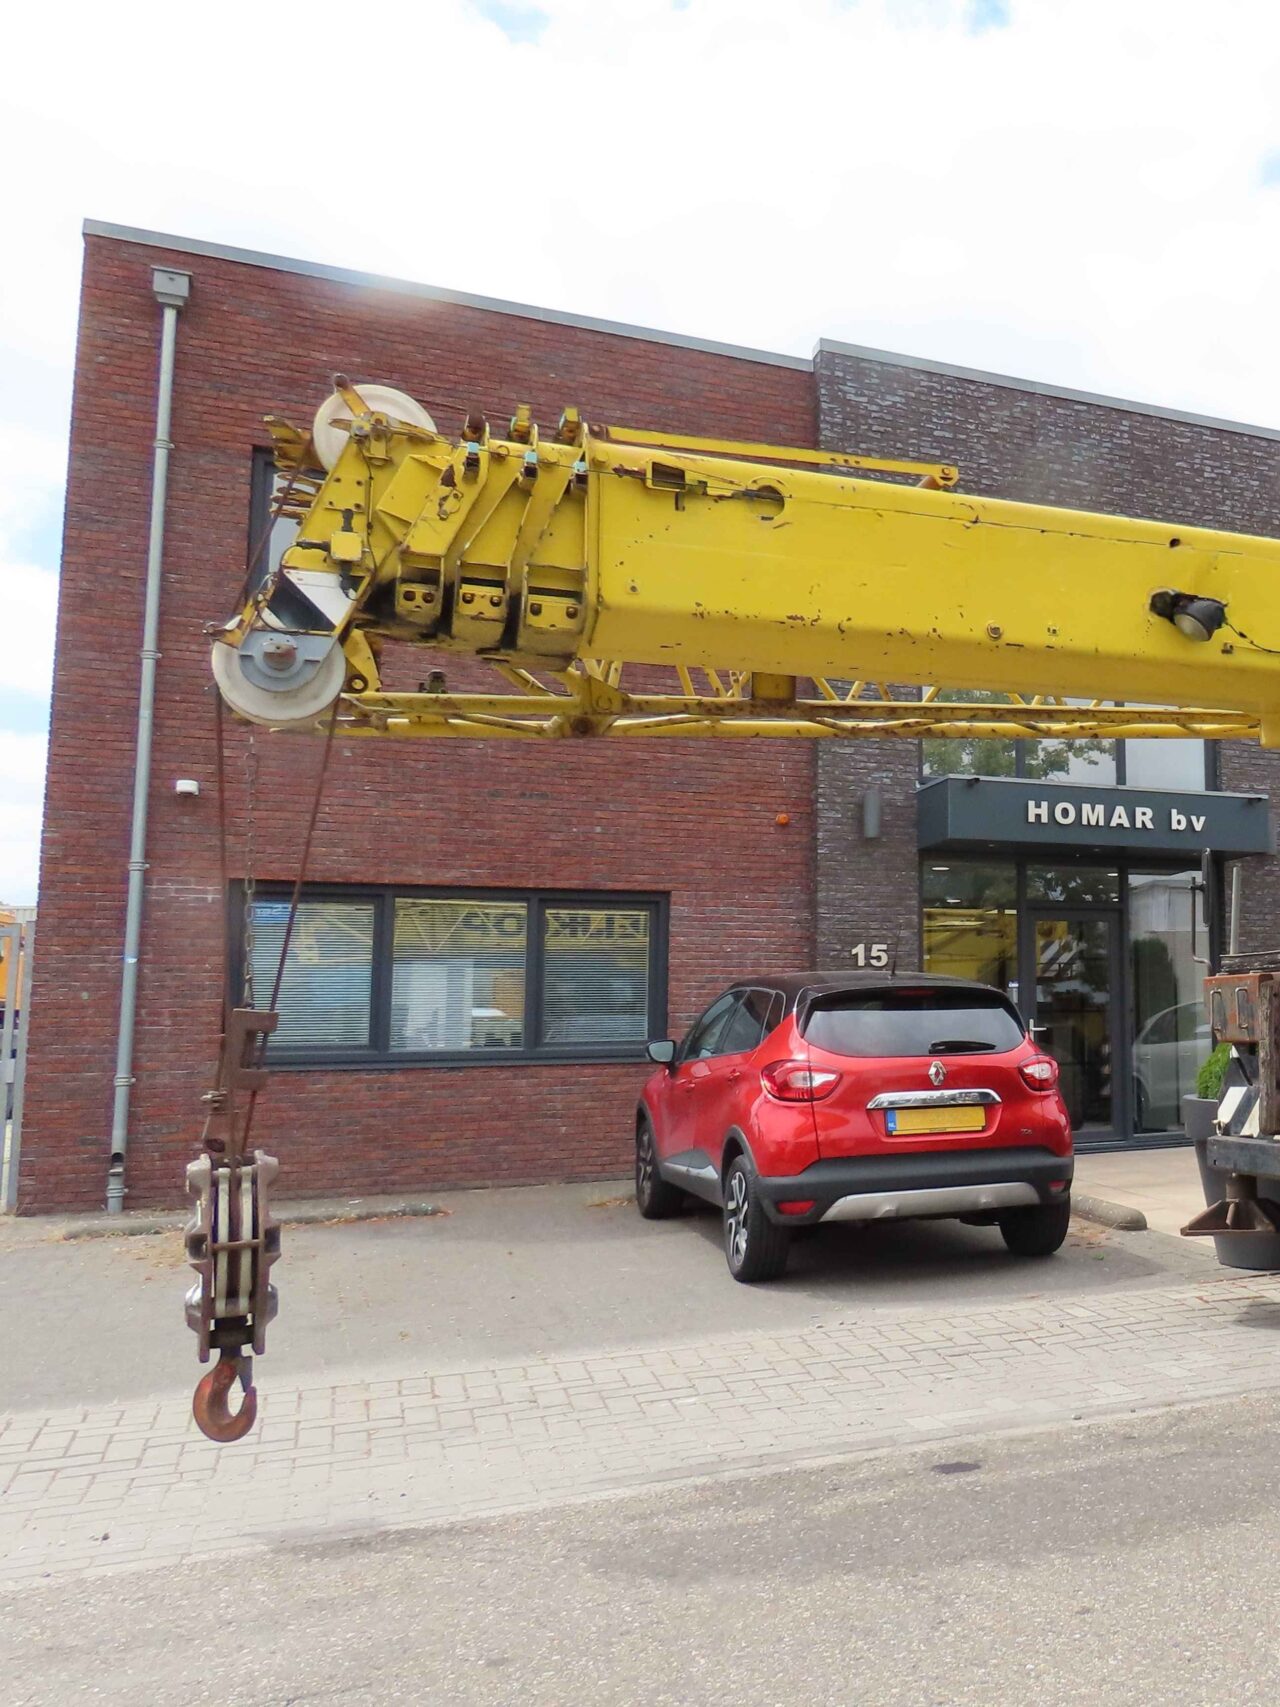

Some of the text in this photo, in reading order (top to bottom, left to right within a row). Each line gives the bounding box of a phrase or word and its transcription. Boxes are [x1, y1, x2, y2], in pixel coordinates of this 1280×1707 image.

[1027, 800, 1206, 832] HOMAR bv
[851, 943, 889, 967] 15
